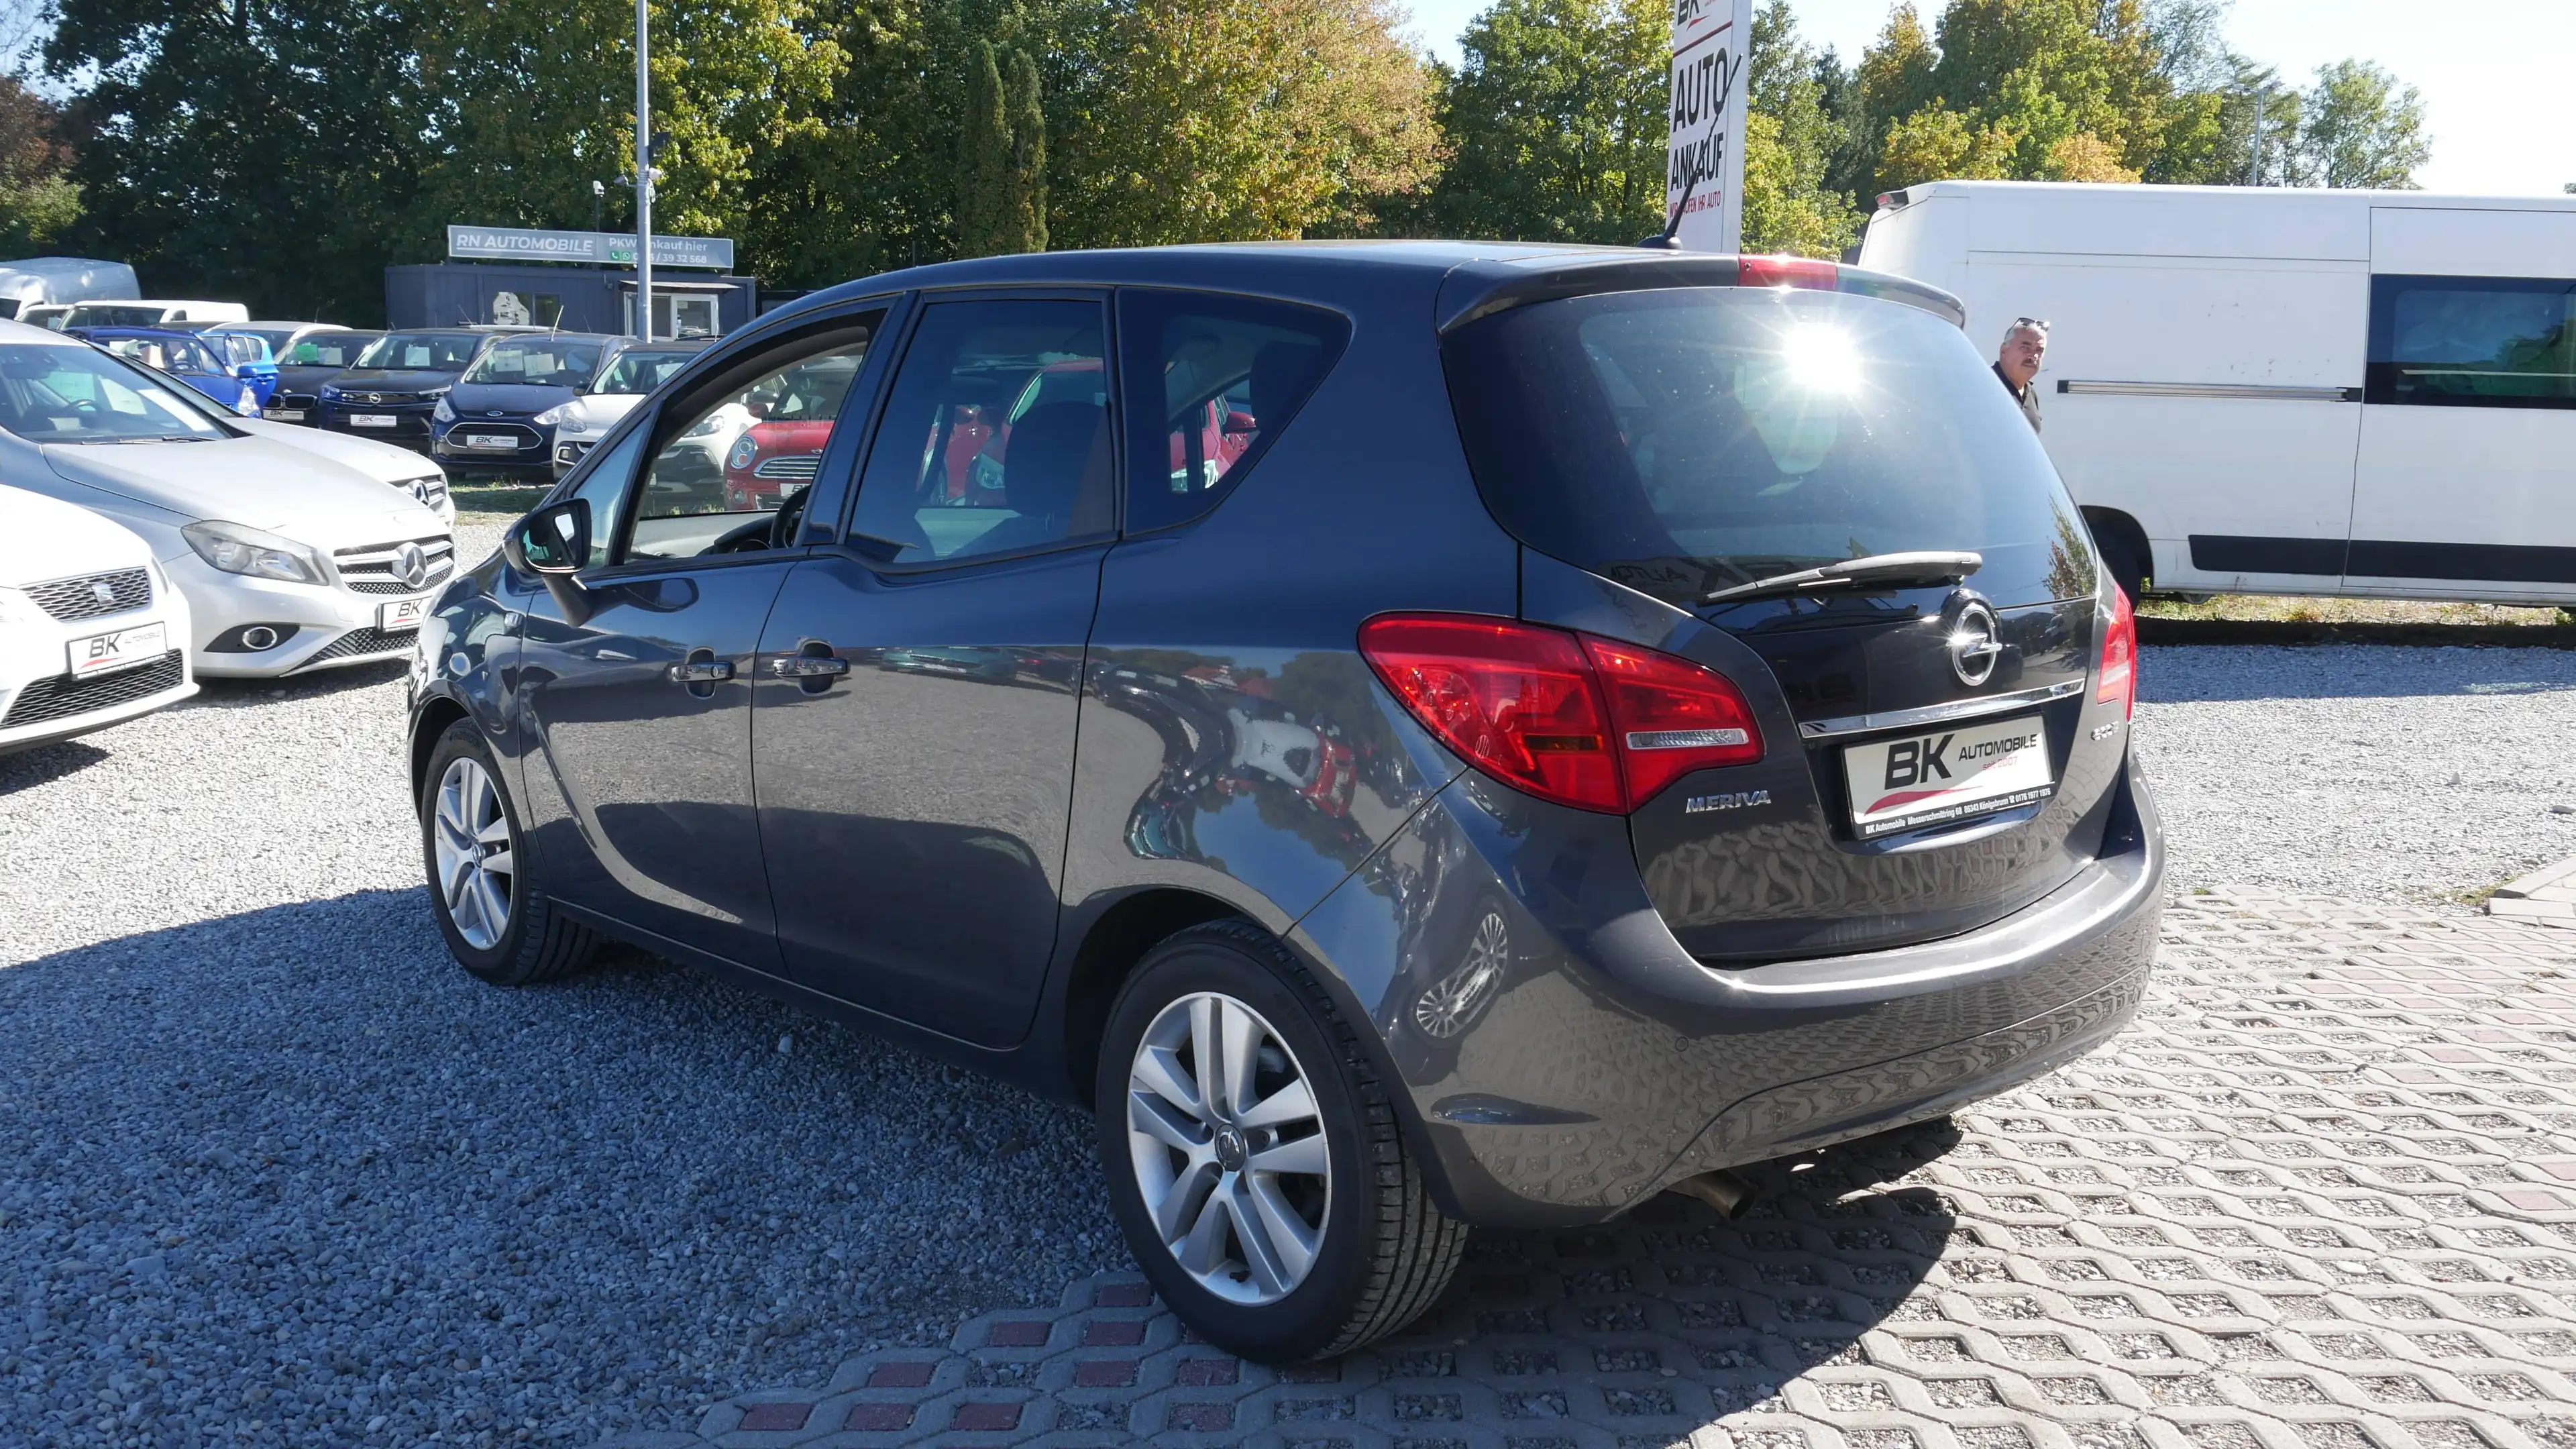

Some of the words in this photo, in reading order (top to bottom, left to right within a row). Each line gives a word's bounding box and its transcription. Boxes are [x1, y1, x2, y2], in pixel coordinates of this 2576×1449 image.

[1672, 48, 1728, 133] AUTO
[1670, 131, 1724, 192] ANKAUF
[1707, 191, 1721, 209] AUTO
[456, 234, 481, 248] RN
[484, 235, 593, 252] AUTOMOBILE
[686, 241, 708, 251] hier
[676, 255, 688, 263] 32
[690, 256, 707, 264] 568
[397, 599, 423, 617] BK
[89, 633, 122, 659] BK
[1884, 733, 1955, 790] BK
[1958, 734, 2038, 762] AUTOMOBILE
[1997, 756, 2018, 768] 2007
[1685, 790, 1772, 813] MERIVA
[1865, 825, 1875, 835] BK
[1875, 818, 1906, 832] Automobile
[1979, 798, 2008, 810] Königsbrunn
